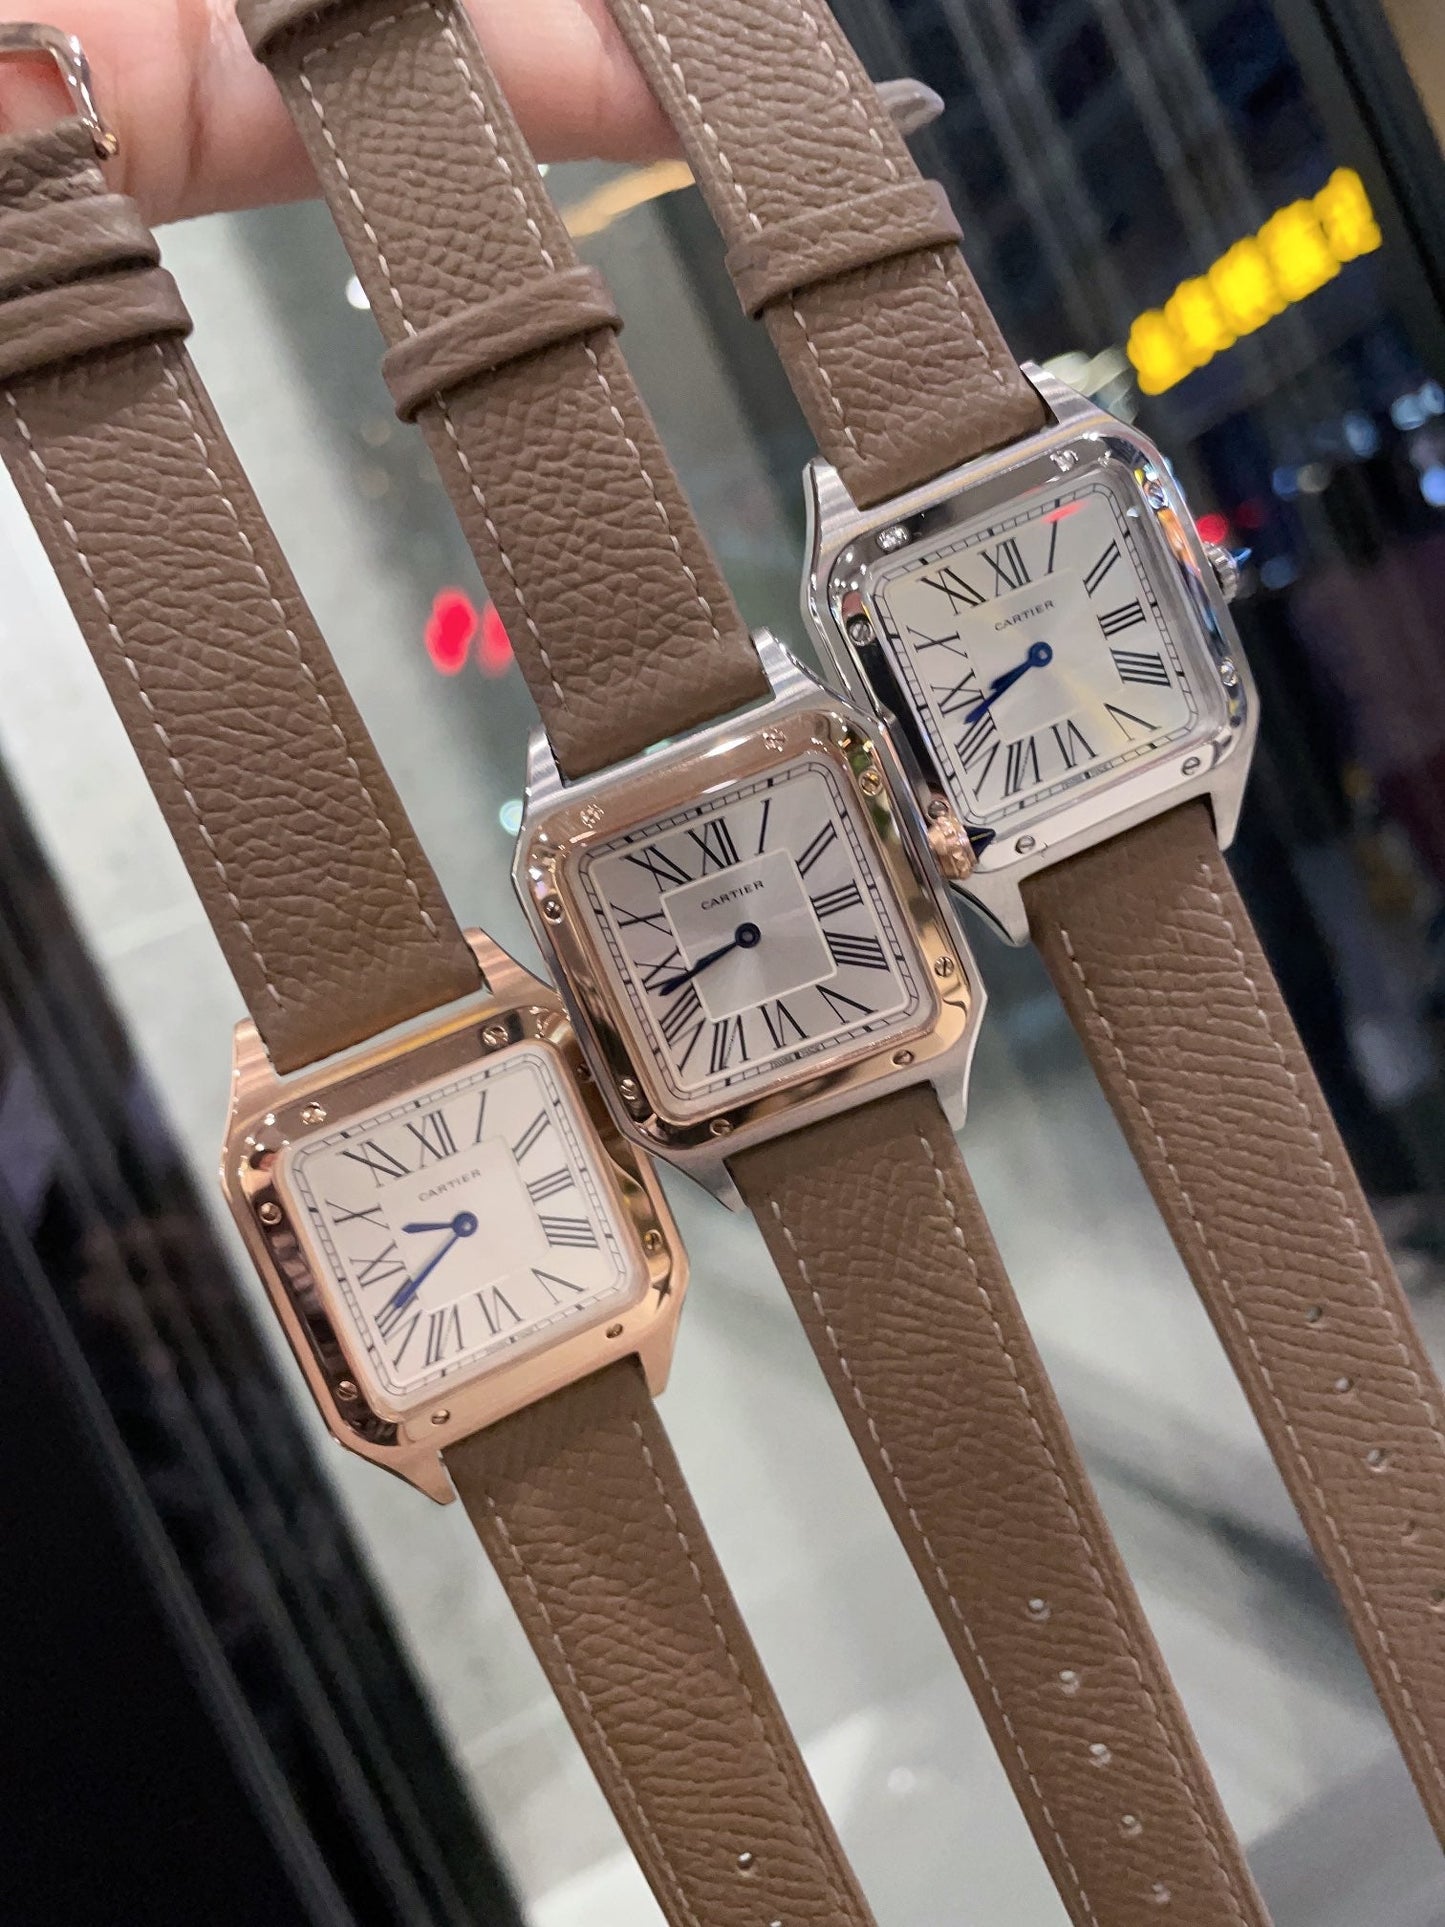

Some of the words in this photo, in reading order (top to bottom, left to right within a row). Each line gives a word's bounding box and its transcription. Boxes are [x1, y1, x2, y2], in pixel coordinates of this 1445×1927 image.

[982, 537, 1031, 597] XII
[1083, 540, 1120, 597] II
[918, 567, 986, 615] XI
[994, 600, 1054, 631] CARTIER
[1097, 597, 1145, 639] III
[907, 626, 968, 658] X
[1110, 648, 1171, 688] IIII
[931, 669, 986, 717] IX
[1052, 719, 1096, 769] VI
[1104, 703, 1161, 741] V
[1005, 736, 1042, 798] VII
[621, 844, 695, 892] XI
[687, 817, 740, 875] XII
[796, 820, 837, 878] II
[700, 880, 764, 910] CARTIER
[810, 880, 864, 920] III
[610, 903, 674, 936] X
[823, 930, 889, 971] IIII
[760, 1000, 809, 1049] VI
[815, 985, 878, 1024] V
[659, 986, 705, 1076] VIII
[706, 1015, 750, 1076] VII
[406, 1110, 458, 1168] XII
[511, 1111, 551, 1166] II
[339, 1140, 414, 1187] XI
[419, 1169, 481, 1202] CARTIER
[527, 1167, 575, 1204] III
[326, 1201, 390, 1229] X
[538, 1215, 600, 1249] IIII
[350, 1241, 408, 1286] IX
[531, 1268, 586, 1304] V
[477, 1286, 523, 1335] VI
[424, 1303, 463, 1367] VII
